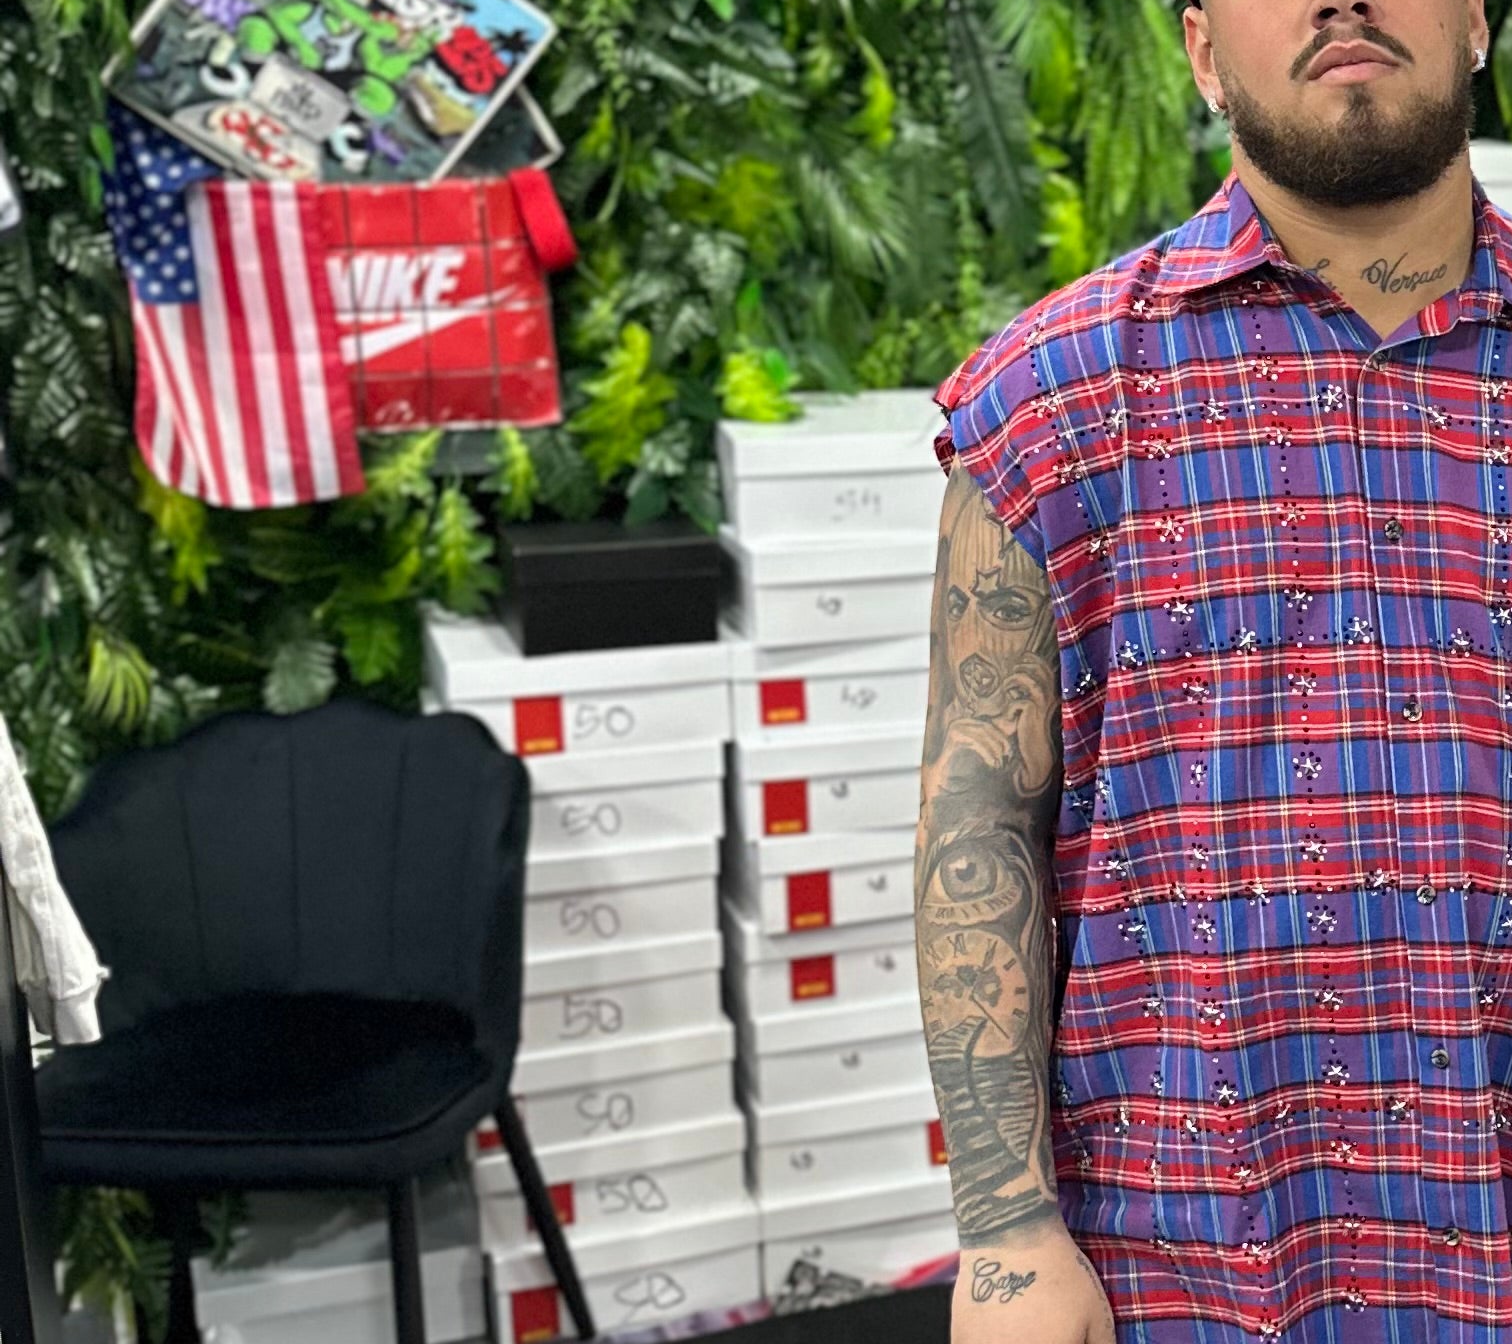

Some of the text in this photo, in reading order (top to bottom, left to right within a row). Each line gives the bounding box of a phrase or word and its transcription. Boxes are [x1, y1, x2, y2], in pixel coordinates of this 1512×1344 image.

[572, 703, 636, 740] 50
[558, 902, 622, 941] 50
[557, 994, 624, 1041] 50
[971, 1257, 1037, 1304] Carpe
